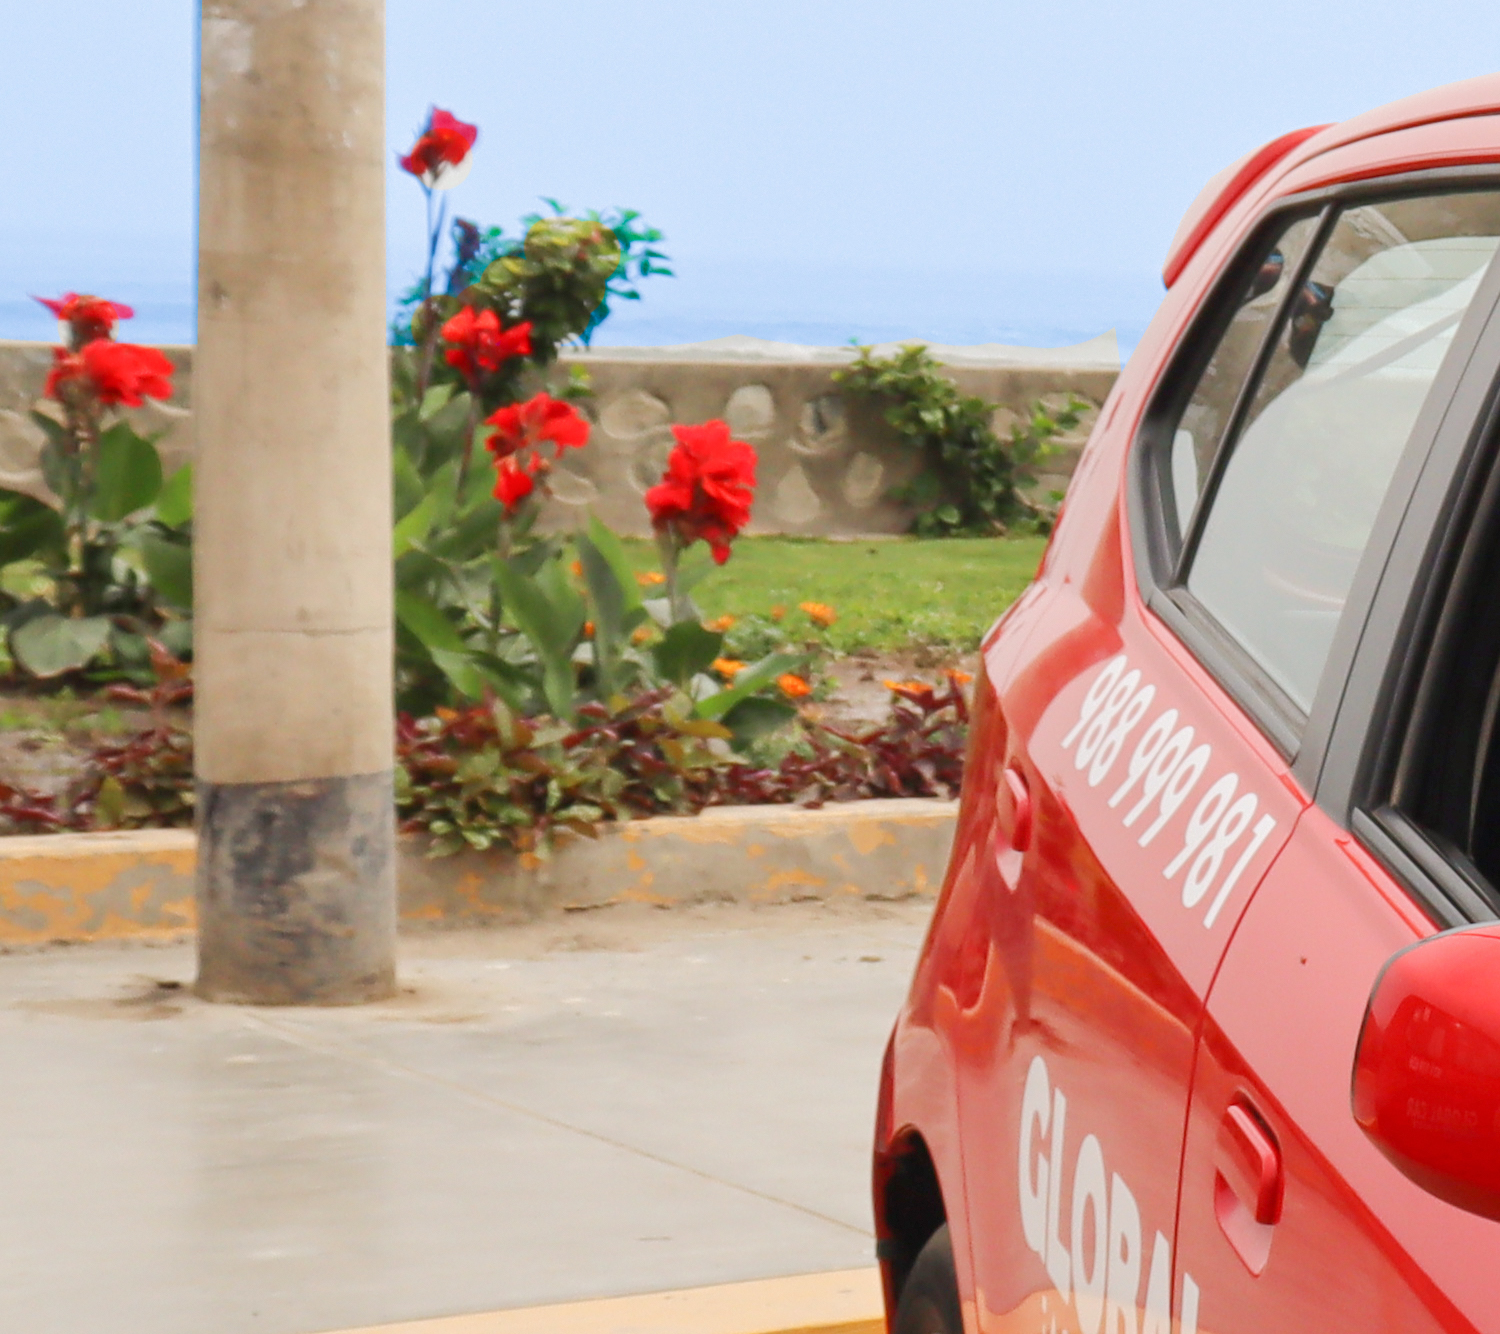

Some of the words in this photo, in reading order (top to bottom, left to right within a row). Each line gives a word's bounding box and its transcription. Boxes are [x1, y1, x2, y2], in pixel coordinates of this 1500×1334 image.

[1060, 654, 1156, 787] 988
[1107, 708, 1211, 848] 999
[1162, 772, 1277, 930] 981
